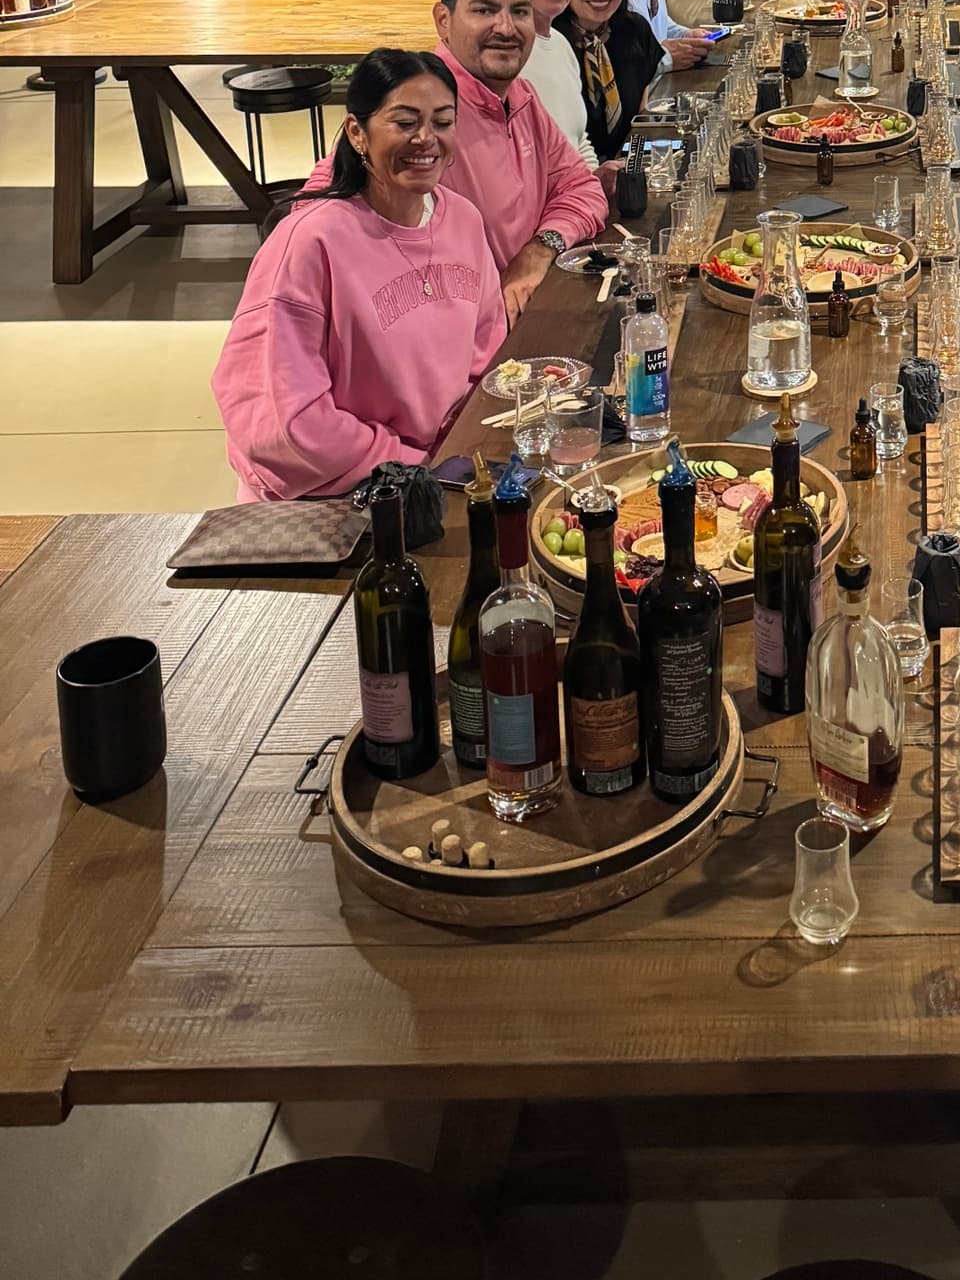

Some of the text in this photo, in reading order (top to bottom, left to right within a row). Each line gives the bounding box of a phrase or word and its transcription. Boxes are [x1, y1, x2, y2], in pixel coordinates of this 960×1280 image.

[372, 263, 445, 331] KENTUCKY
[647, 350, 667, 362] LIFE
[647, 360, 667, 371] WTR
